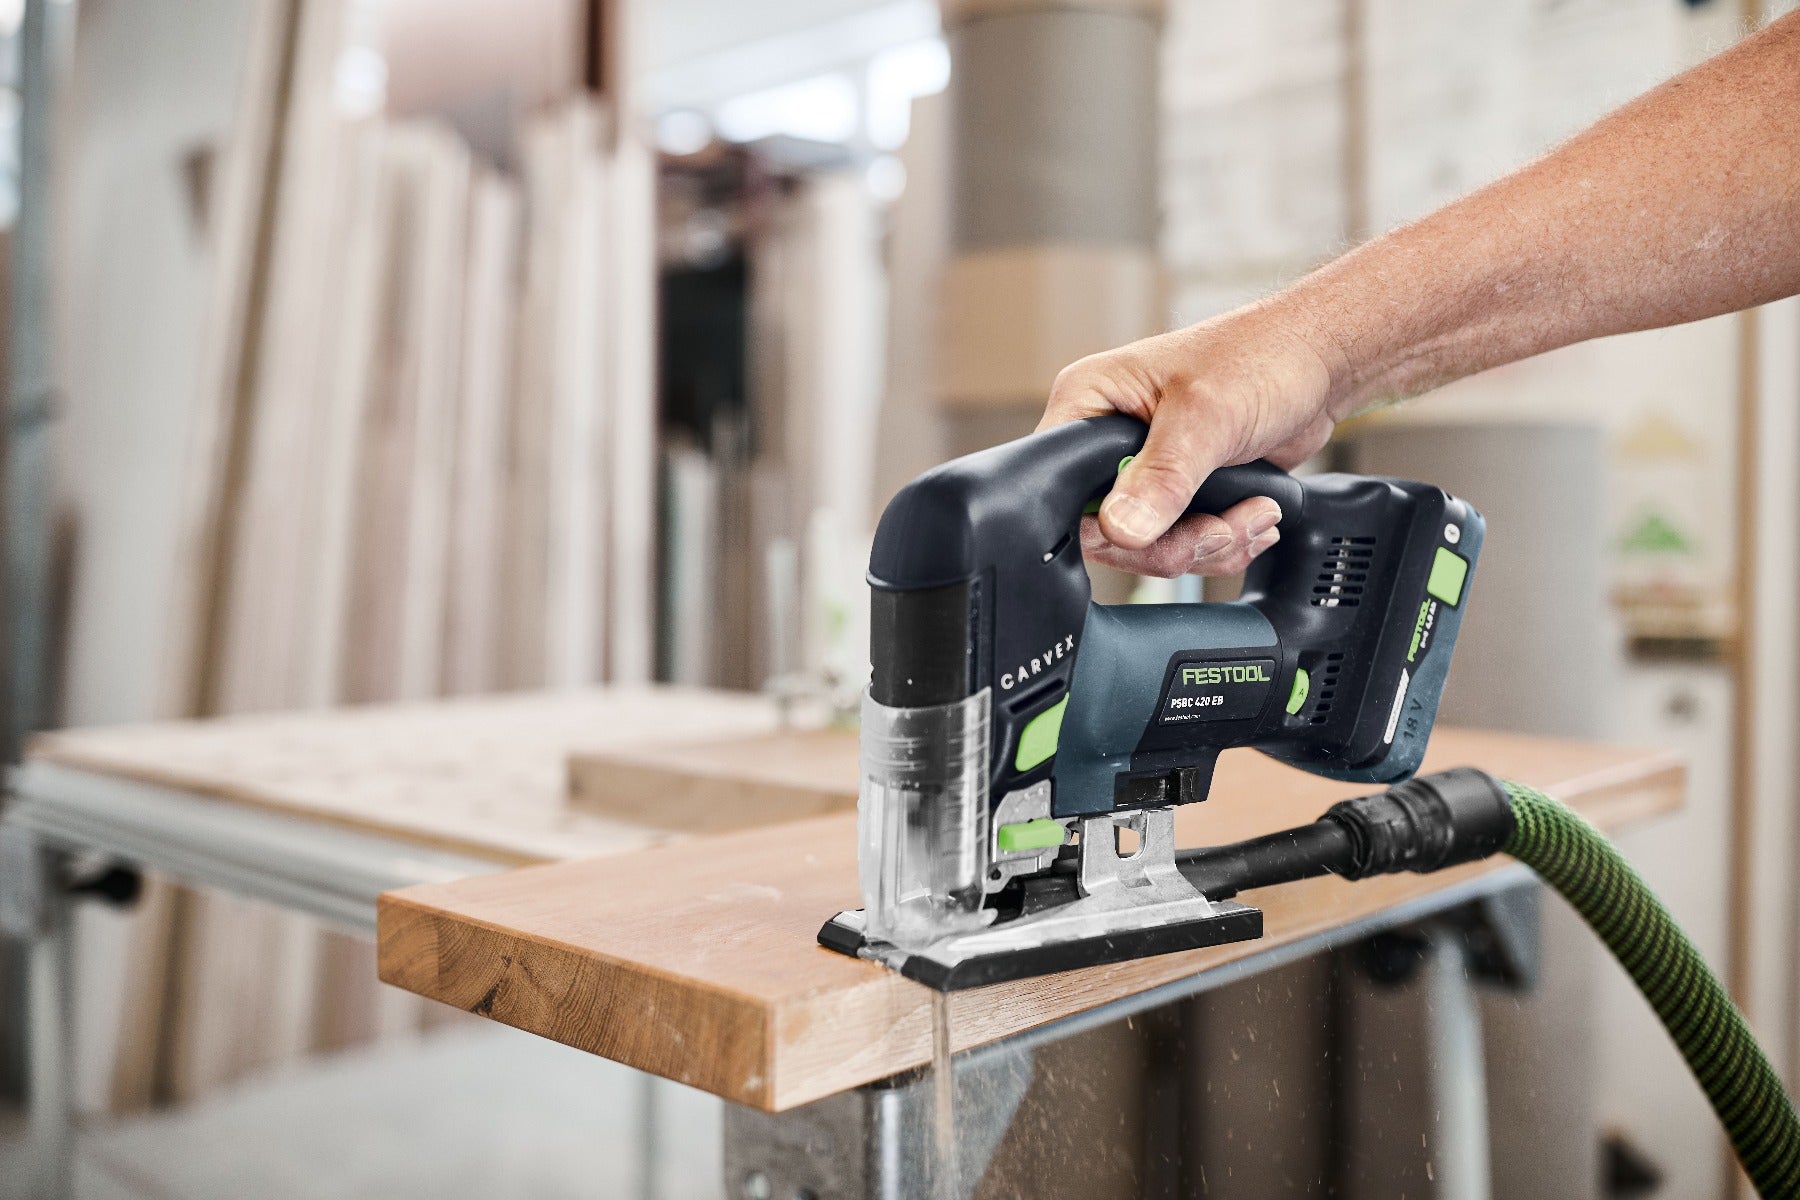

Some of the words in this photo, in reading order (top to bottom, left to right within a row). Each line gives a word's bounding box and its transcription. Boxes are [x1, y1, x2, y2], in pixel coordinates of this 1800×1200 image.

[1000, 634, 1074, 689] CARVEX
[1182, 665, 1271, 685] FESTOOL
[1170, 698, 1194, 709] PSBC
[1194, 696, 1210, 706] 420
[1211, 695, 1224, 706] EB
[1410, 698, 1423, 711] V
[1403, 717, 1418, 739] 18
